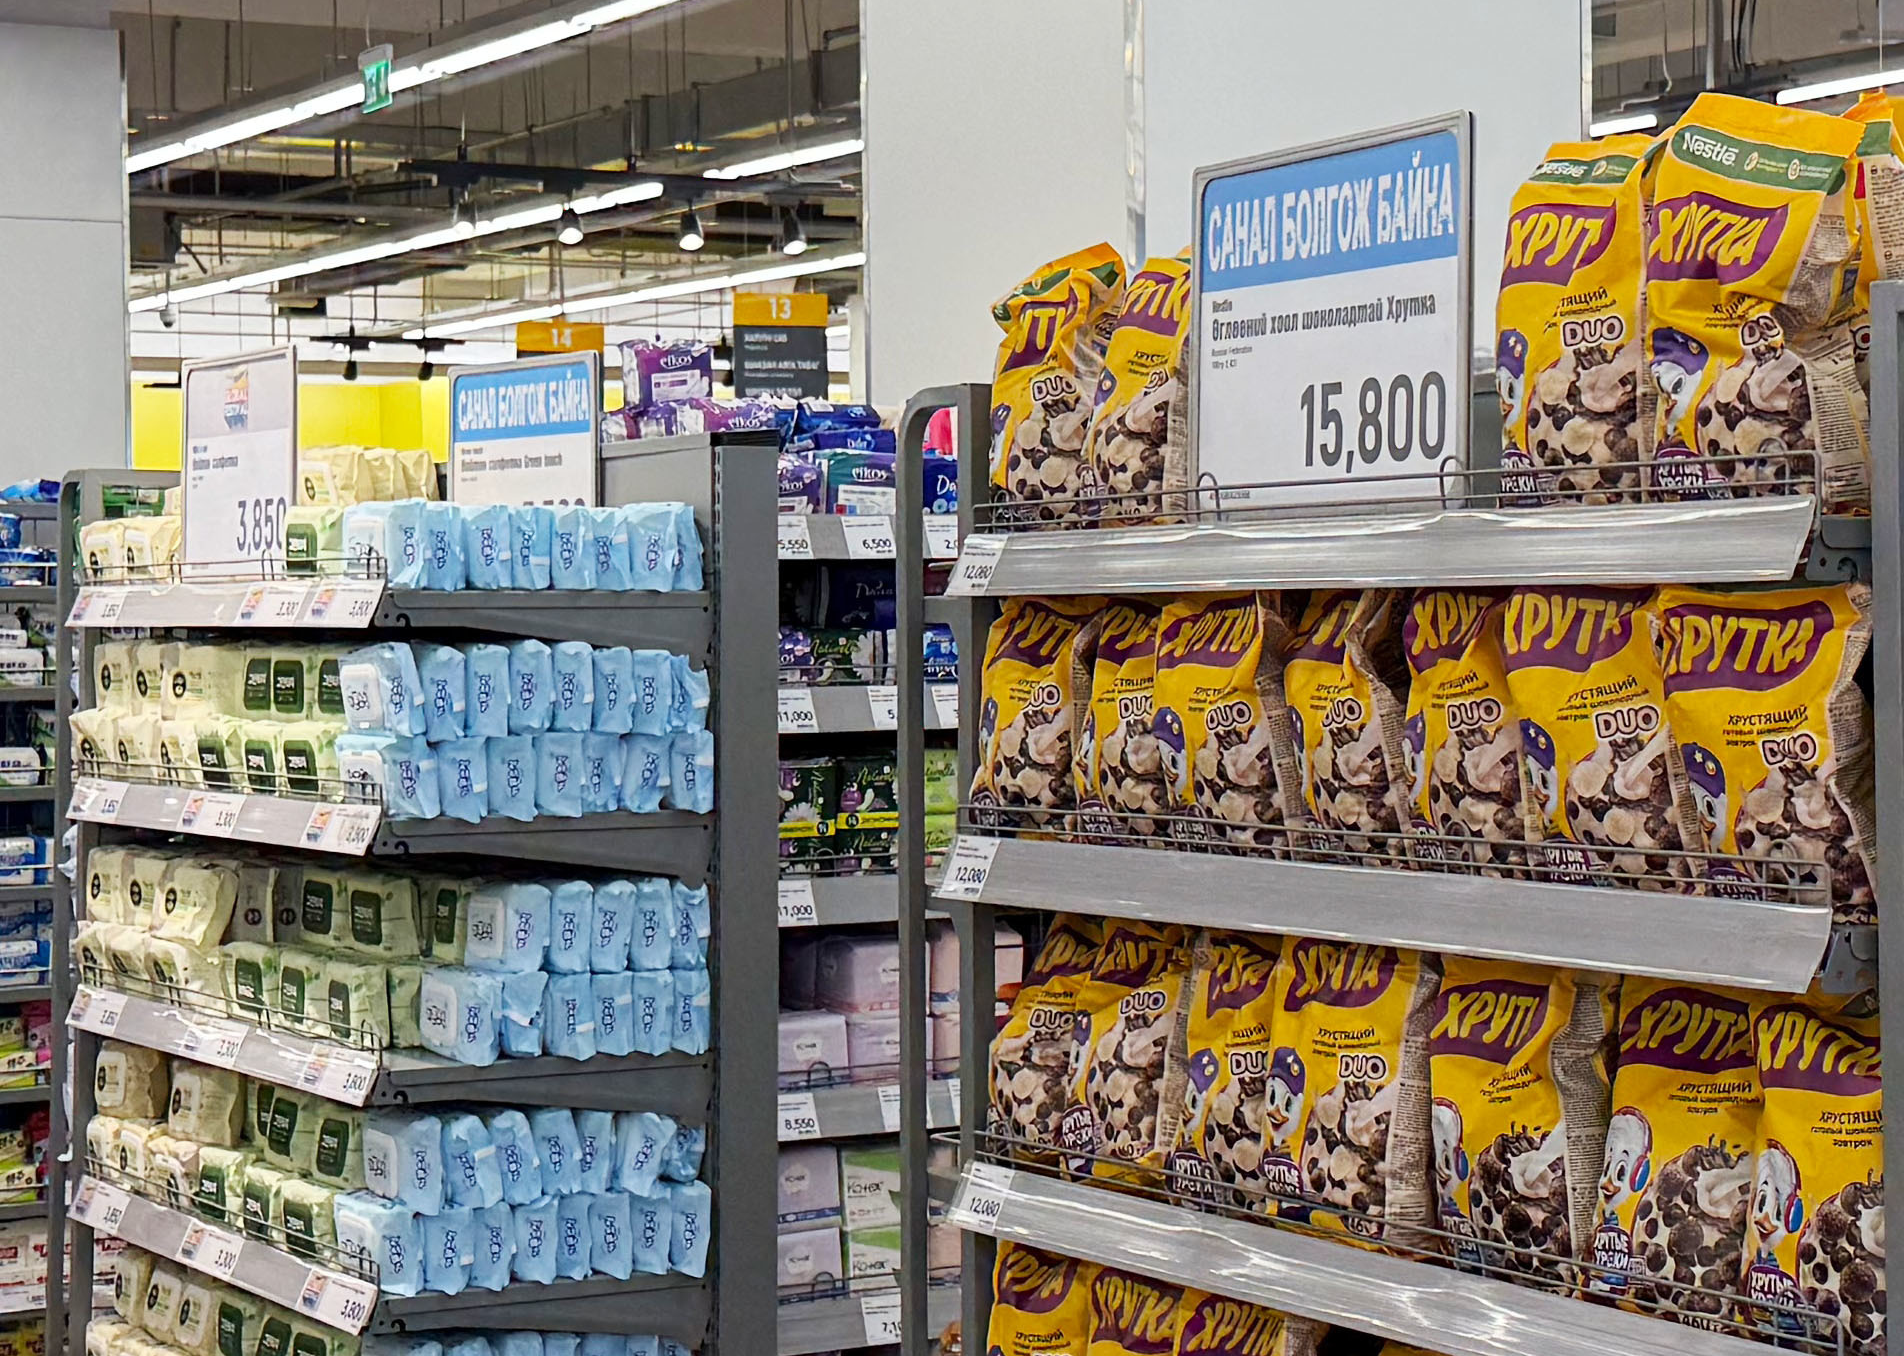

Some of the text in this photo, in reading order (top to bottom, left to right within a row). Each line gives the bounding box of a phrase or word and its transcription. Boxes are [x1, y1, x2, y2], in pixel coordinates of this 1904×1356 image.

[1208, 150, 1454, 272] САНАЛ БОЛГОЖ БАЙНА
[769, 299, 791, 319] 13
[1563, 315, 1625, 347] DUO
[1301, 372, 1446, 473] 15,800
[862, 538, 892, 550] 6,500
[1446, 696, 1502, 733] DUO
[1596, 705, 1660, 739] DUO
[1118, 988, 1166, 1016] DUO
[1338, 1053, 1389, 1082] DUO
